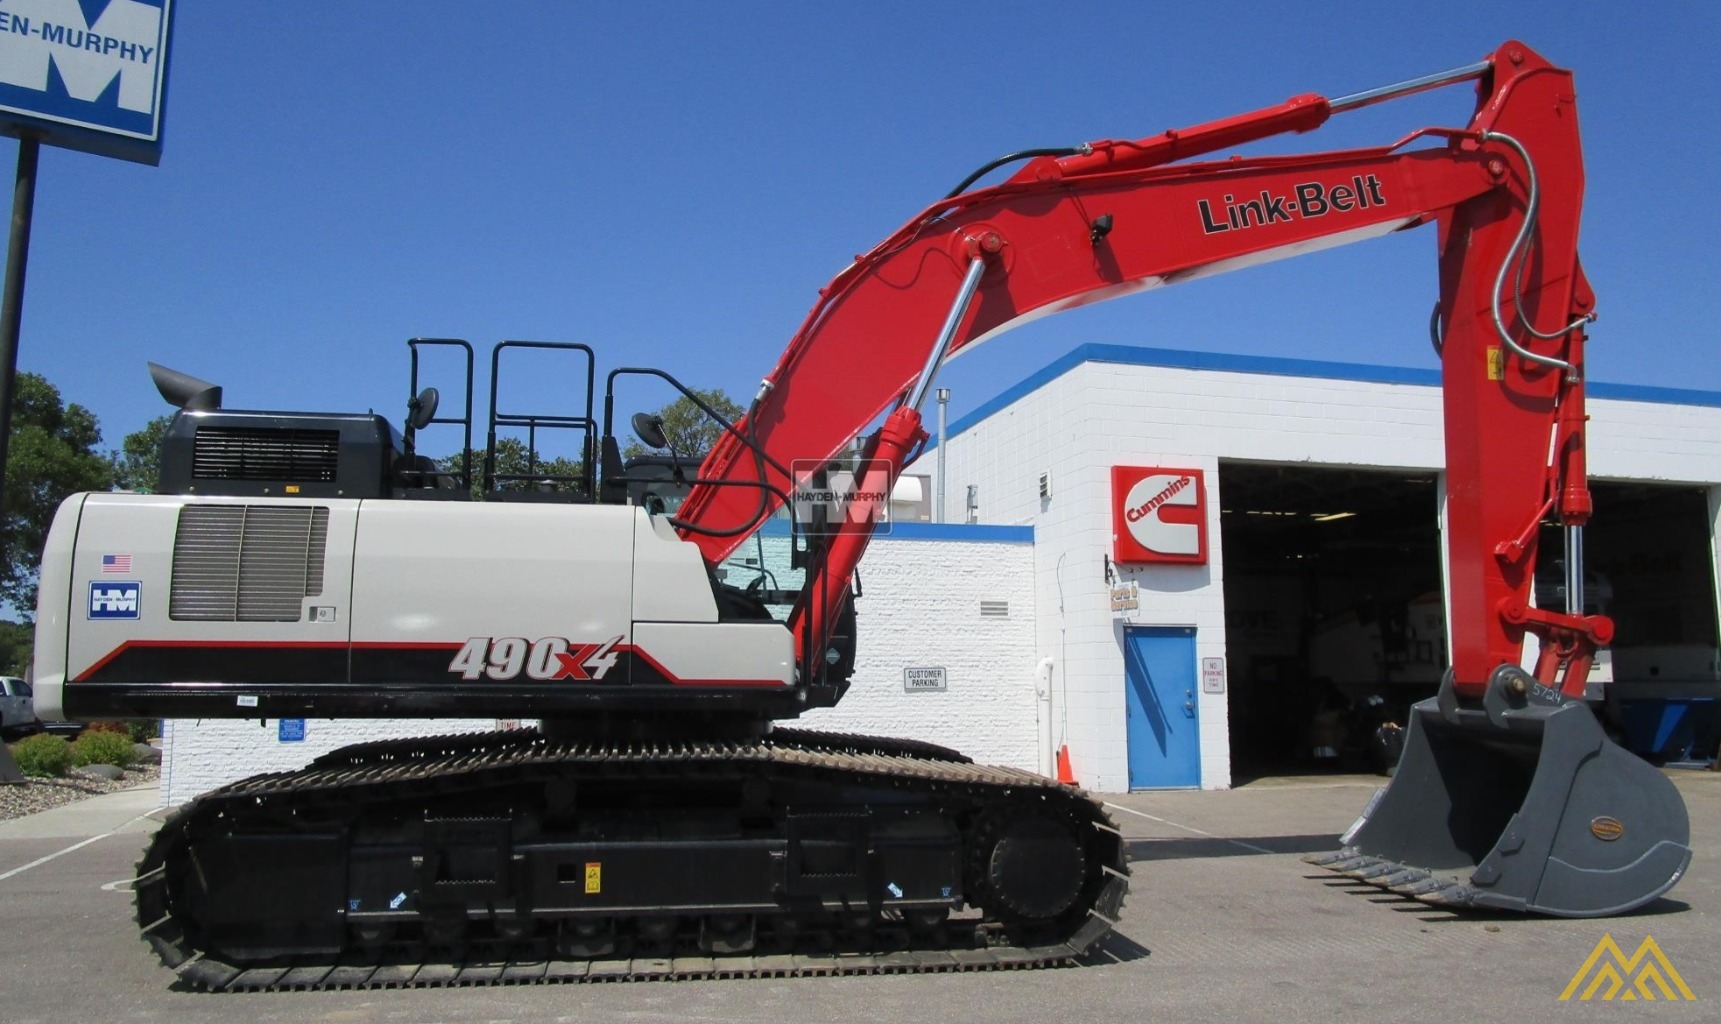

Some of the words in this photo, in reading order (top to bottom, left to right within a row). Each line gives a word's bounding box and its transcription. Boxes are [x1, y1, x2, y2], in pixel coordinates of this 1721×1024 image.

[1197, 174, 1386, 235] Link-Belt
[1126, 475, 1190, 523] Cummins
[92, 589, 137, 612] HM
[908, 670, 942, 679] CUSTOMER
[911, 679, 939, 687] PARKING
[1532, 683, 1561, 704] 5724
